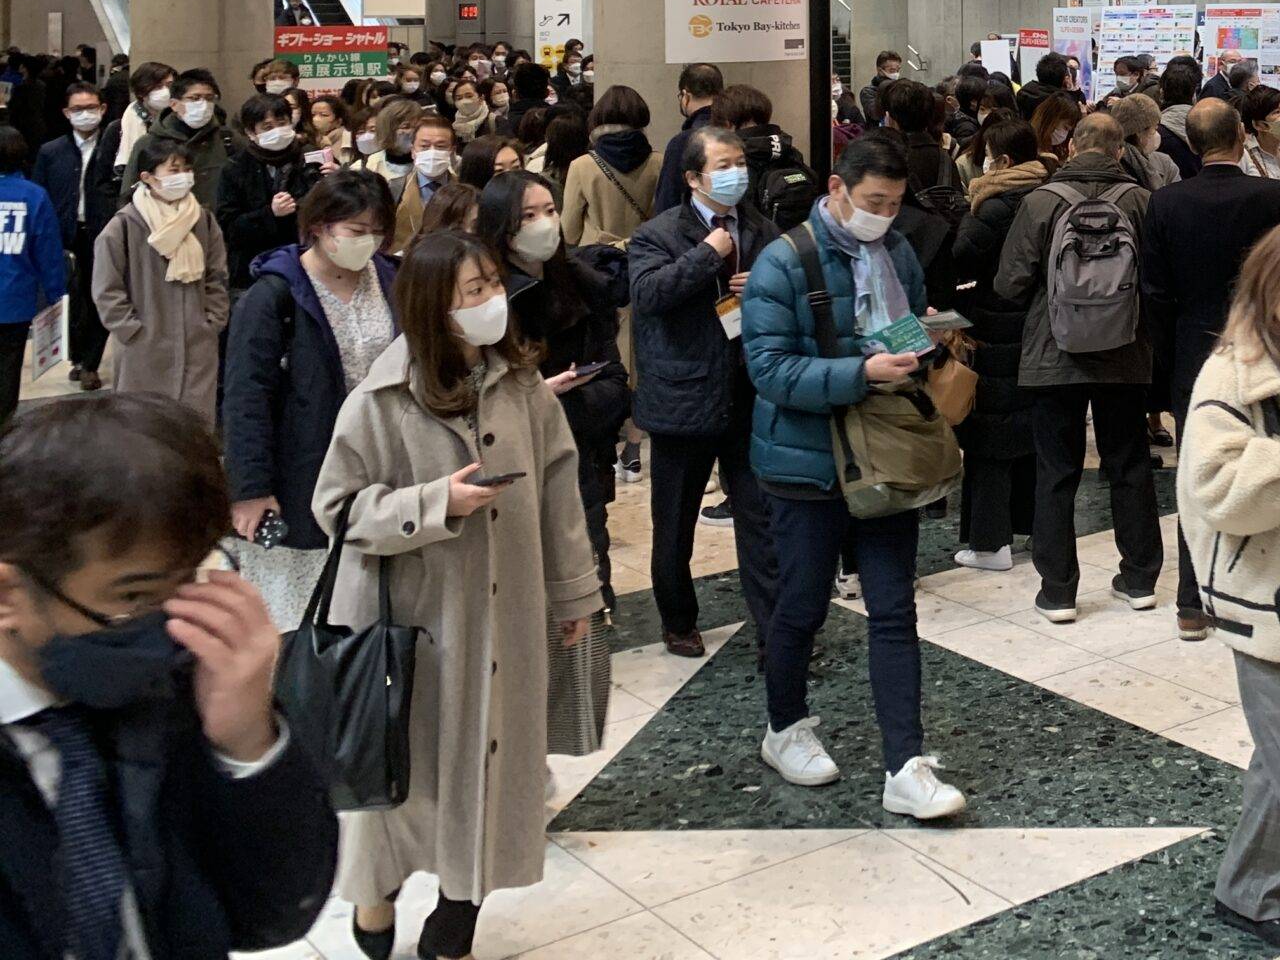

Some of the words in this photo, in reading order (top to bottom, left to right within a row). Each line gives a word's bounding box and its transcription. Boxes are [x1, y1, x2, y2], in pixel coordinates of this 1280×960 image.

[716, 21, 750, 33] Tokyo
[753, 21, 800, 32] Bay-kitchen
[345, 32, 385, 46] シャトル
[304, 52, 360, 63] りんかい線
[298, 63, 381, 77] 際展示場駅
